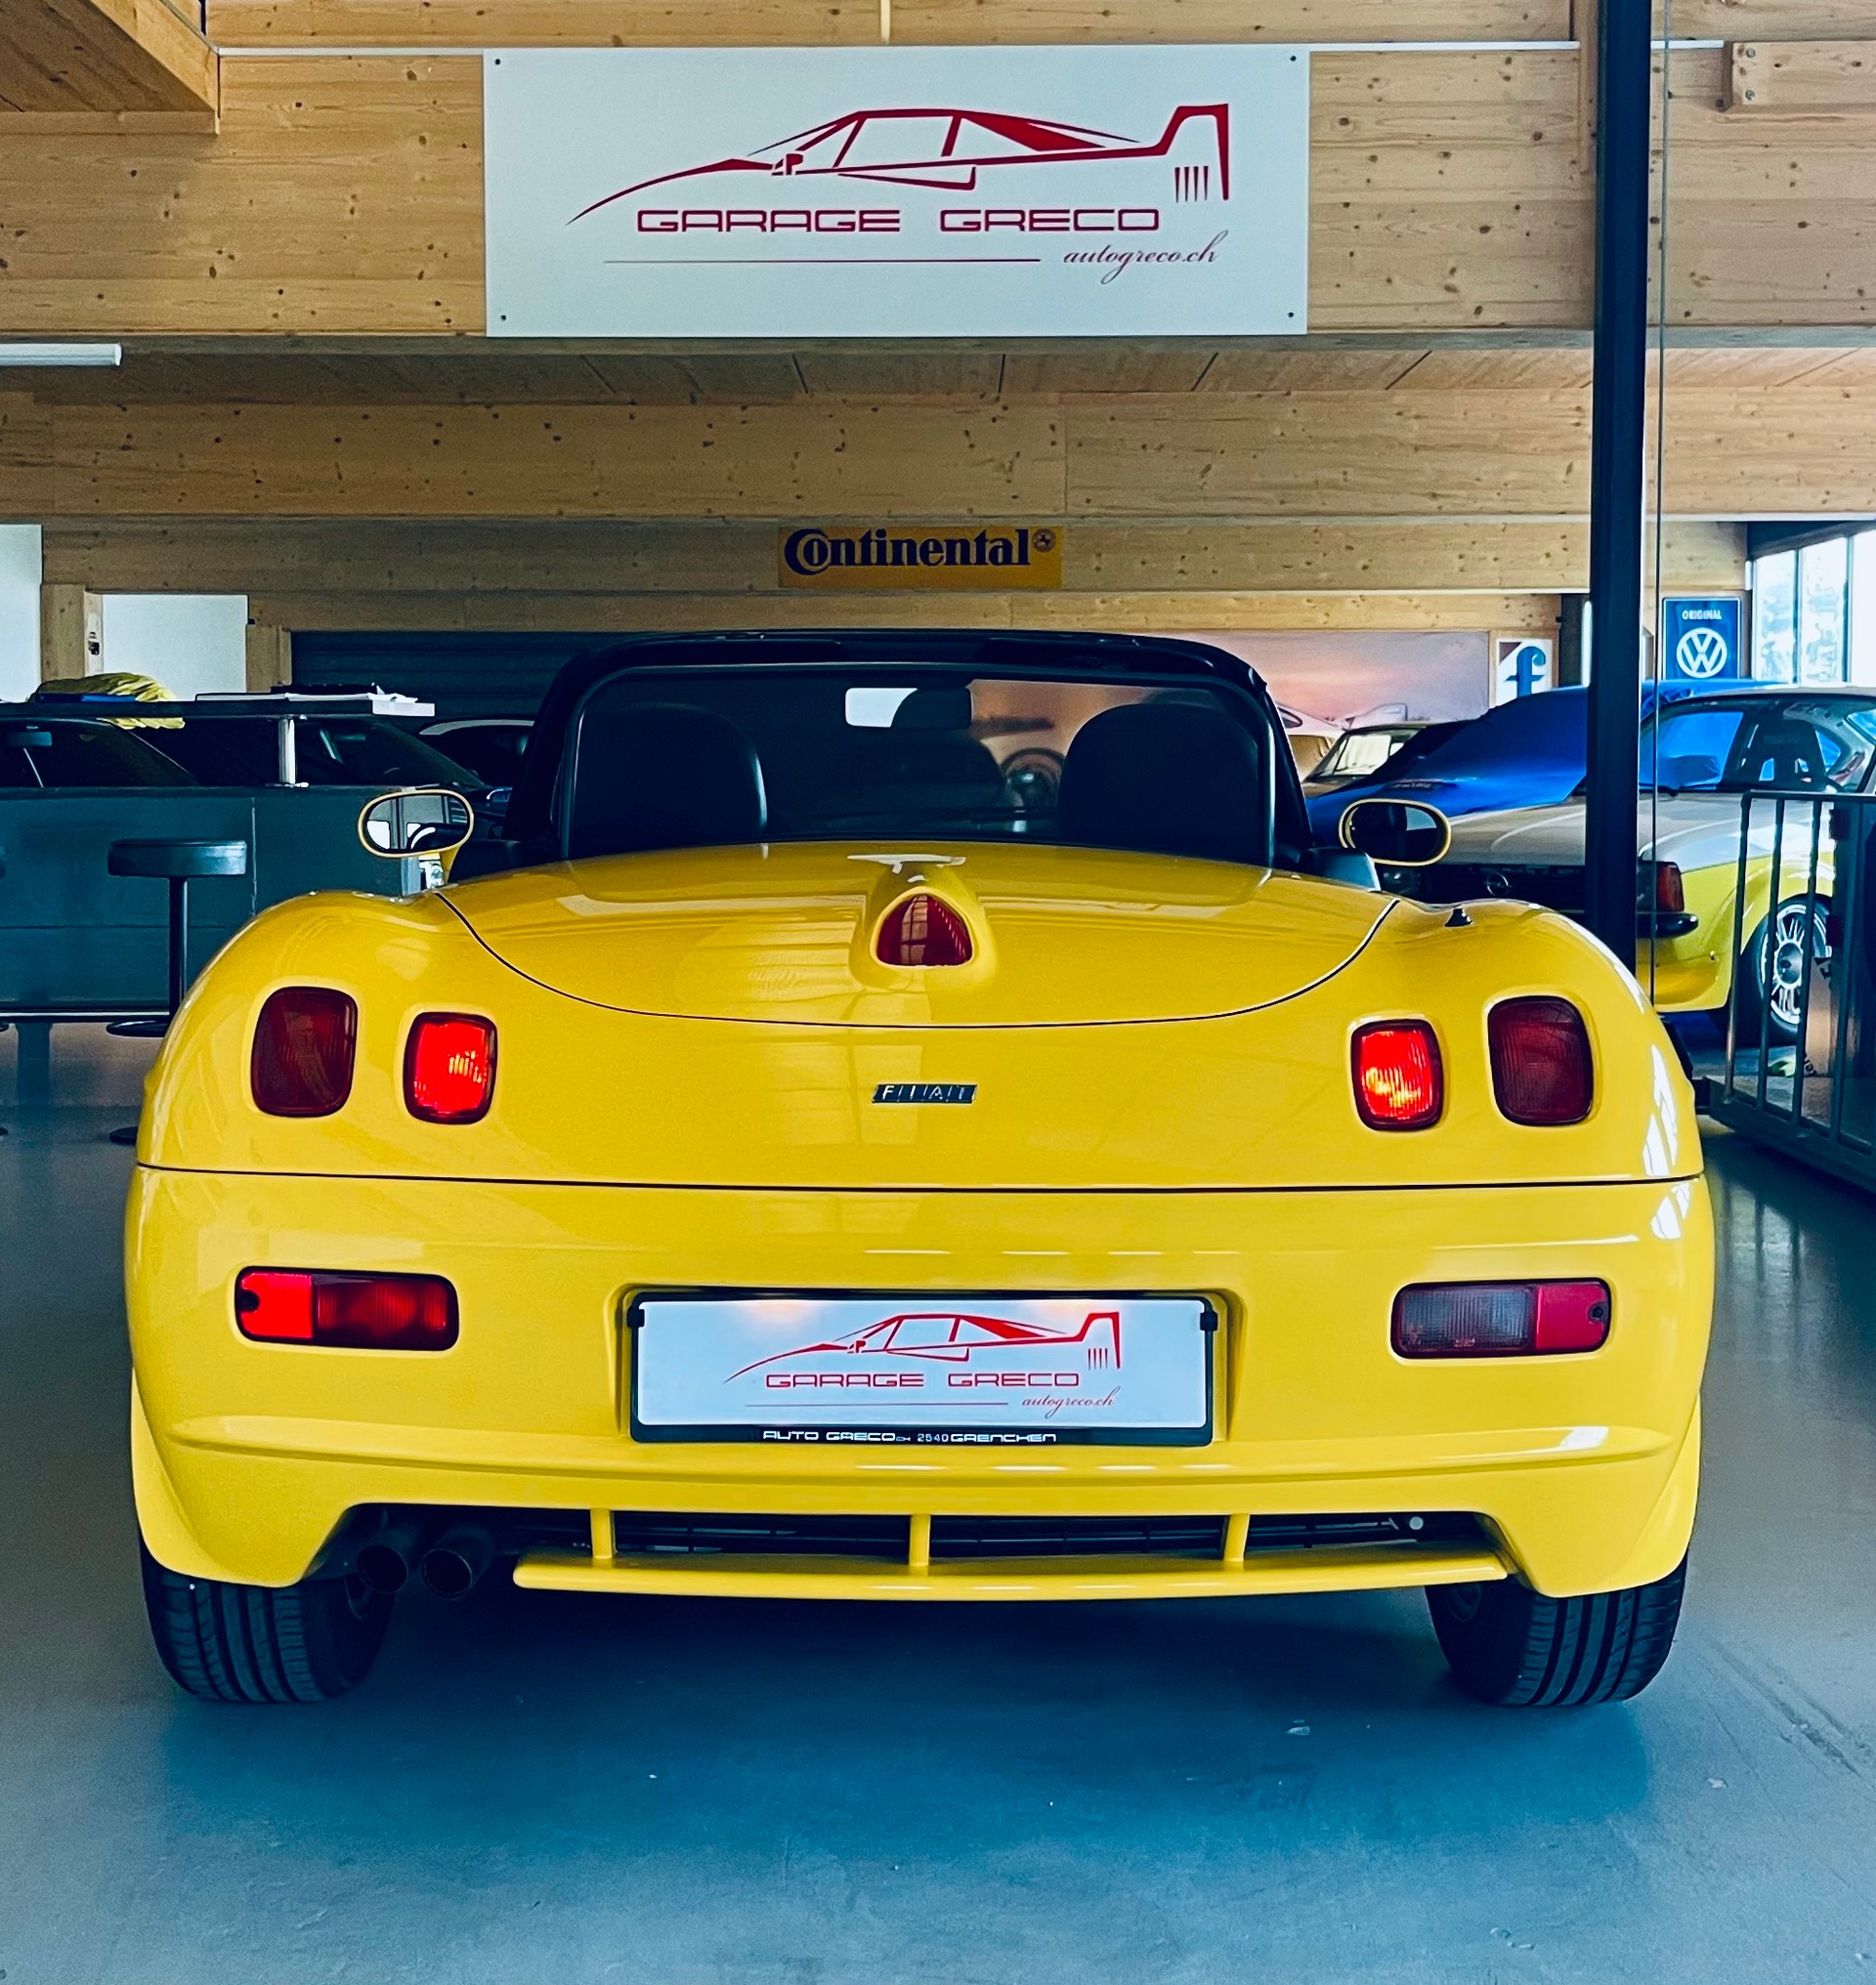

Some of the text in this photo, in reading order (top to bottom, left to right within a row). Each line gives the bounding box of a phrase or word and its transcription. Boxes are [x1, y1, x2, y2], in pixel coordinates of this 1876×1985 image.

[636, 208, 1160, 232] GARAGE GRECO
[1062, 229, 1229, 285] autogreco.ch
[784, 528, 1031, 575] Continental
[1682, 609, 1723, 620] ORIGINAL
[881, 1084, 966, 1100] FIAT
[765, 1373, 1080, 1388] GARAGE GRECO
[1021, 1386, 1122, 1419] autogreco.ch
[762, 1430, 820, 1441] AUTO
[917, 1432, 950, 1443] 2540
[950, 1433, 1057, 1443] GRENCHEN
